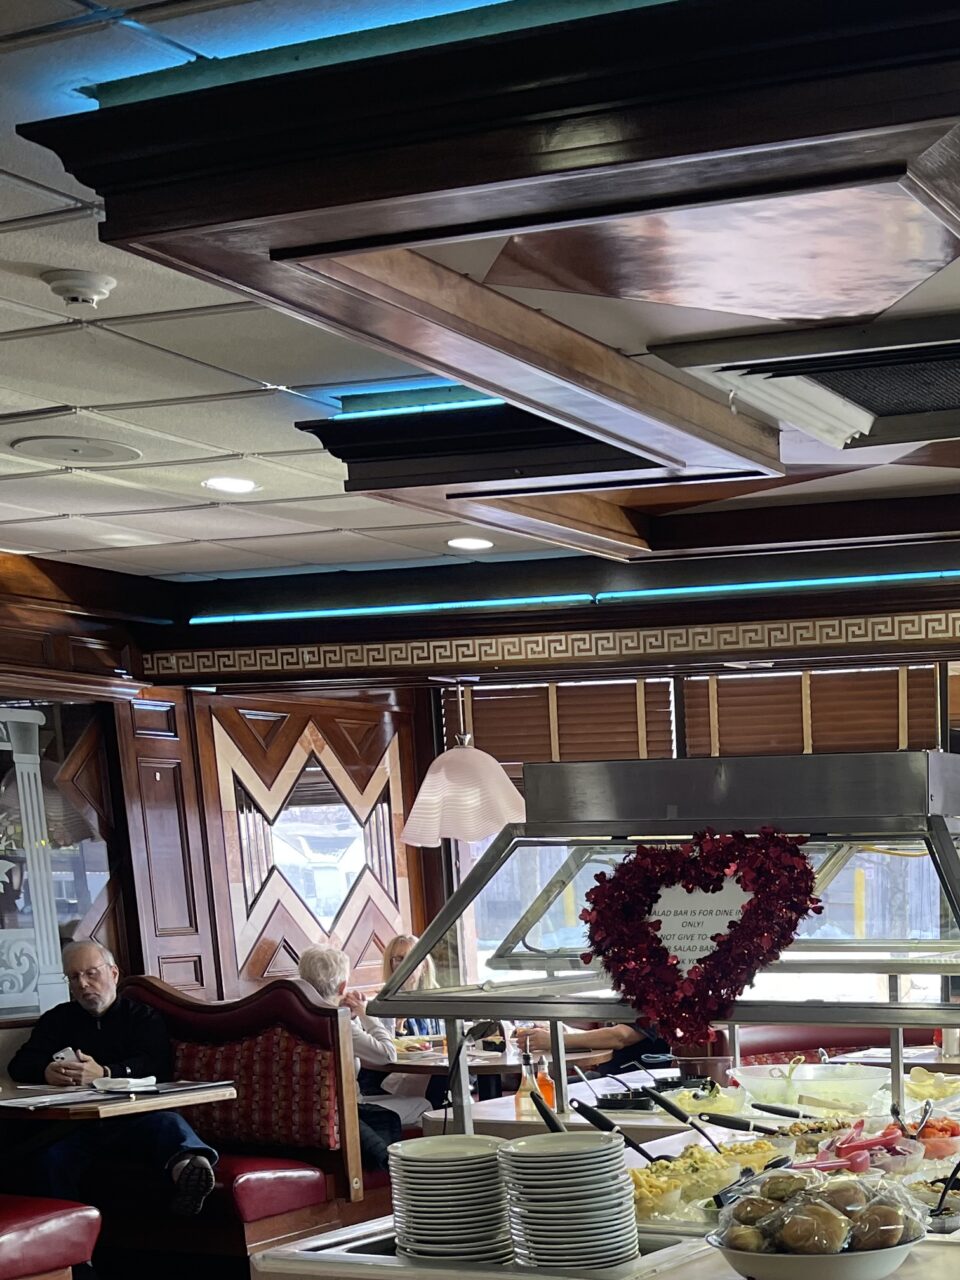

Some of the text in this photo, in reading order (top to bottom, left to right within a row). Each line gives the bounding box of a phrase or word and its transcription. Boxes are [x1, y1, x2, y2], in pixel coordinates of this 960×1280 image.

[651, 909, 672, 917] ALAD
[673, 909, 689, 917] BAR
[690, 909, 697, 917] IS
[699, 909, 714, 917] FOR
[715, 909, 734, 917] DINE
[681, 920, 704, 928] ONLY!
[660, 933, 676, 941] NOT
[677, 933, 695, 941] GIVE
[673, 945, 698, 953] SALAD
